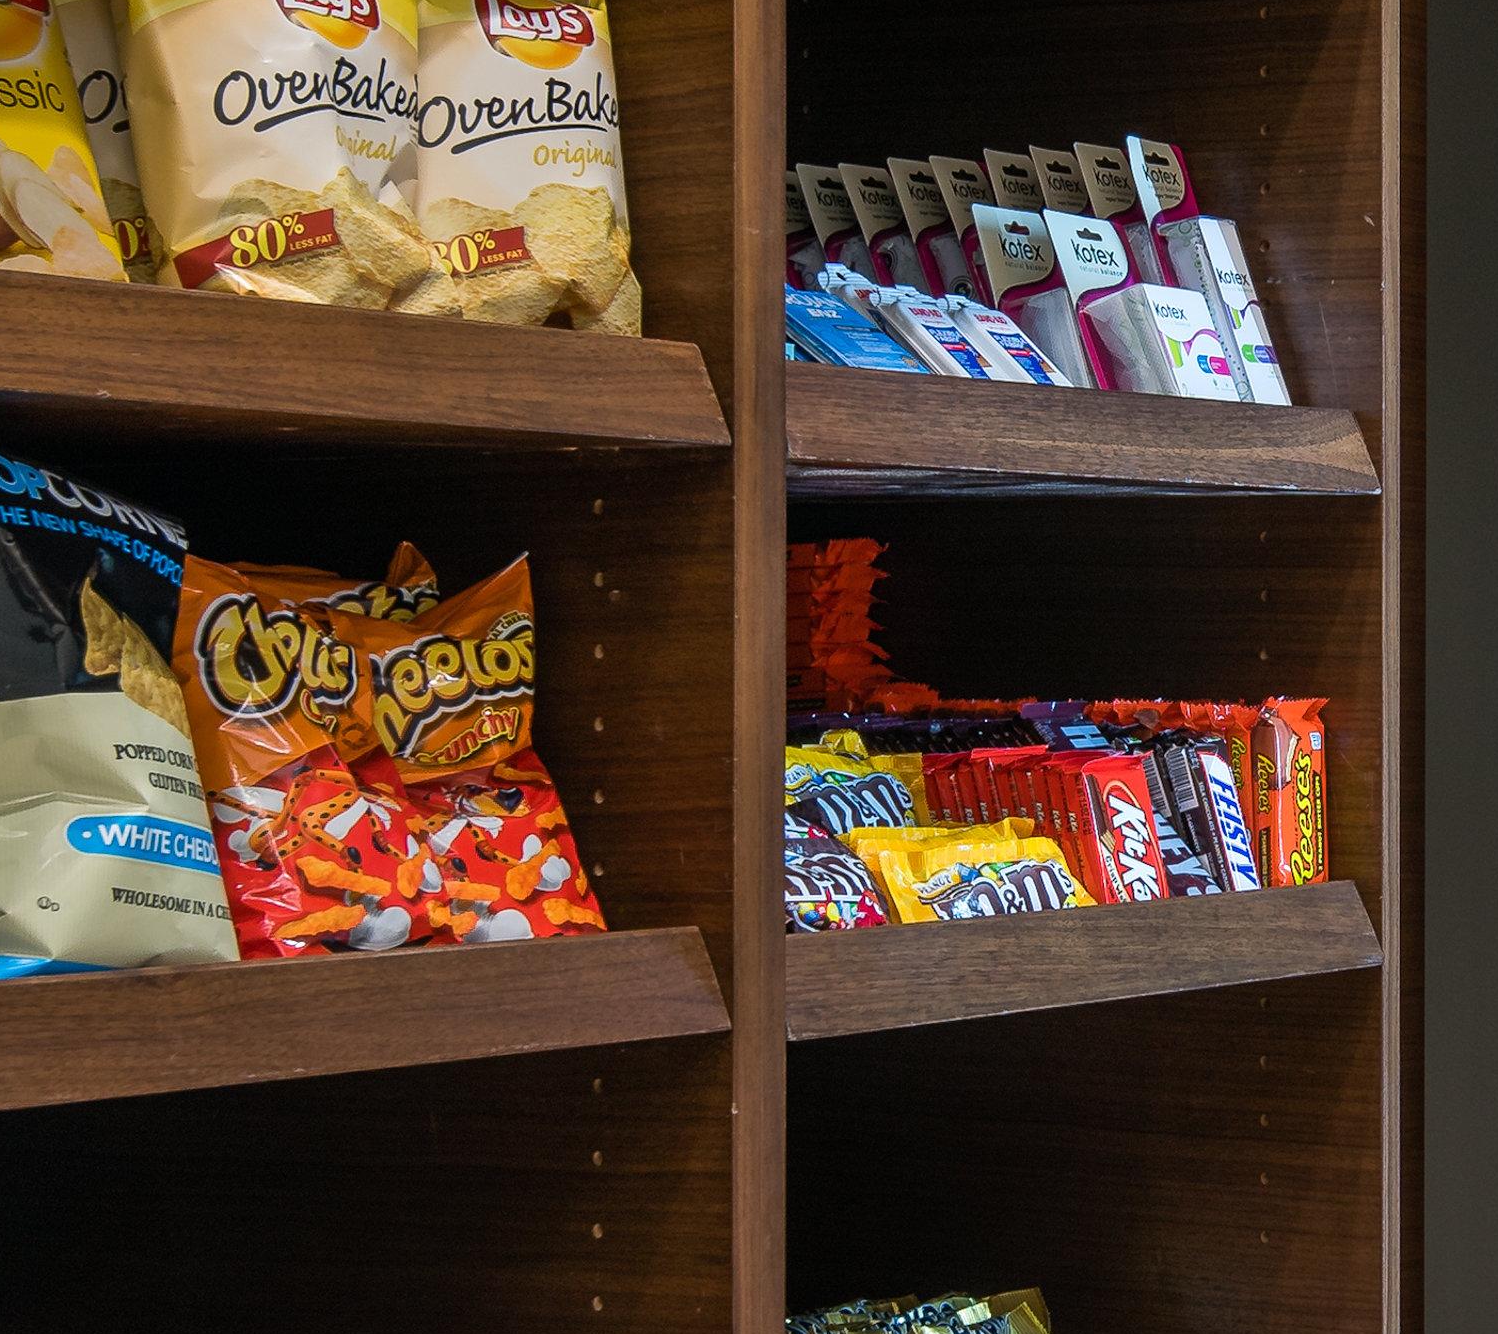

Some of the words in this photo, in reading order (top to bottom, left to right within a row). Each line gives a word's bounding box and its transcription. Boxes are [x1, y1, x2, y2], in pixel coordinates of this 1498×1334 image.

[416, 70, 620, 149] OvenBake
[229, 213, 305, 268] 80%
[289, 239, 313, 251] LESS
[313, 234, 334, 248] FAT
[503, 249, 523, 261] FAT
[1070, 238, 1120, 268] Kotex
[31, 508, 77, 535] NEW
[77, 519, 133, 555] SHAPE
[131, 537, 153, 565] OF
[113, 743, 167, 764] POPPED
[98, 824, 172, 855] WHITE
[1209, 774, 1258, 887] FEISTY
[111, 886, 192, 914] WHOLESOME
